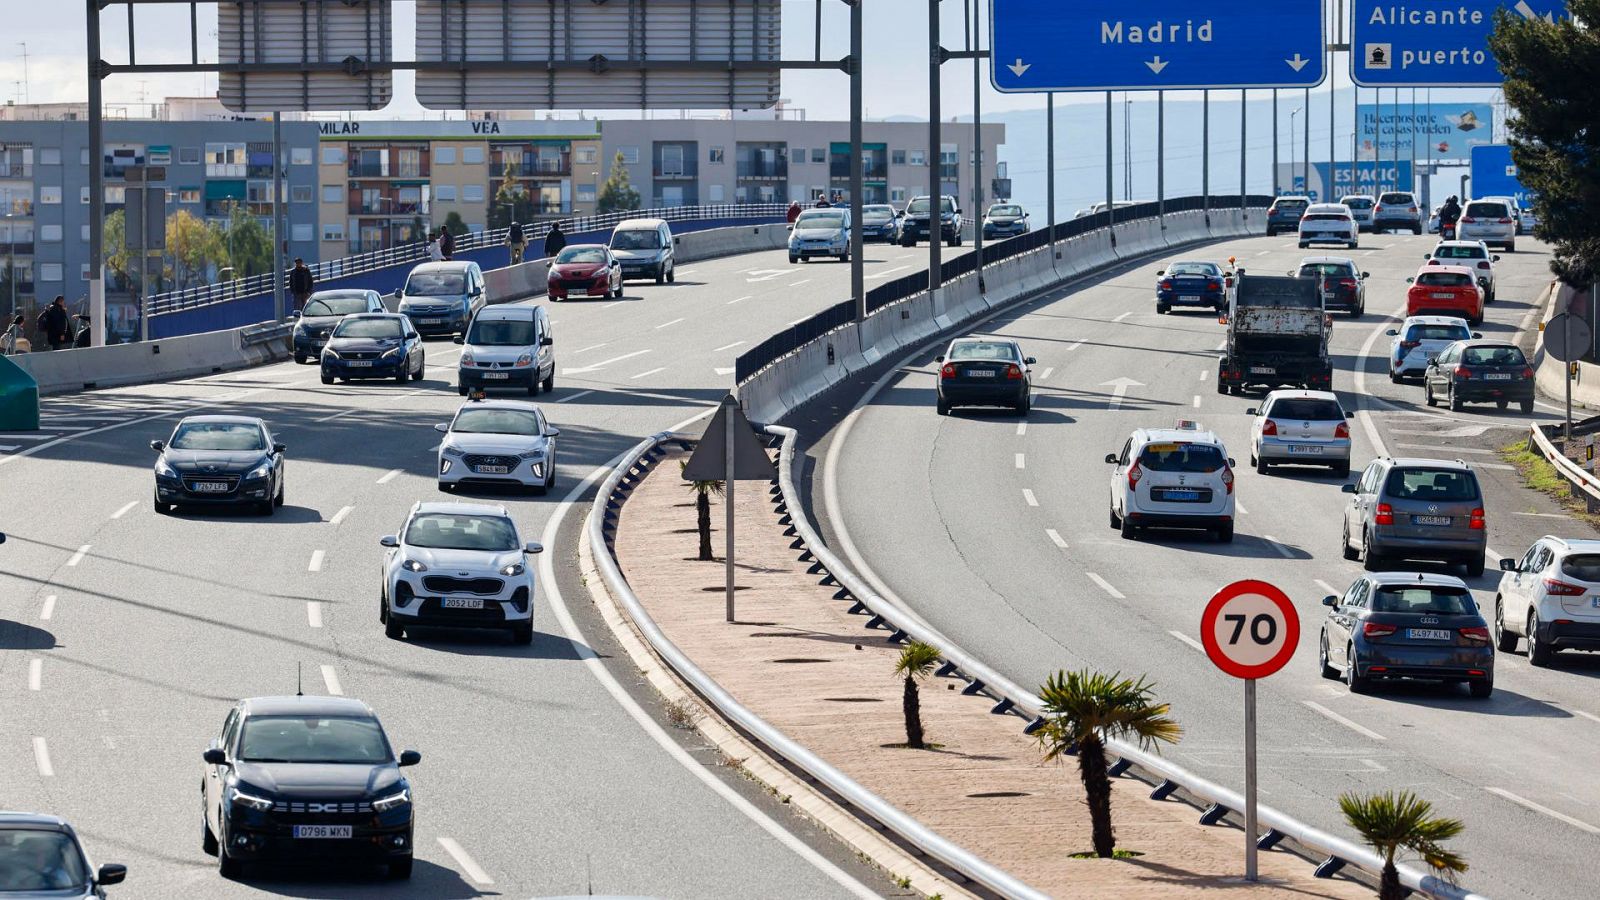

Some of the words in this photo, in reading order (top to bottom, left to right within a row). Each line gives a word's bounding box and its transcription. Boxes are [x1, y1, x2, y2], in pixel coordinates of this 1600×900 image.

[1369, 6, 1483, 25] Alicante
[1101, 19, 1213, 44] Madrid
[1402, 47, 1486, 70] puerto
[319, 122, 360, 134] MILAR
[471, 122, 500, 134] VEA
[1225, 613, 1277, 646] 70
[1411, 629, 1432, 637] 5497
[1433, 630, 1449, 639] KLN
[301, 826, 327, 837] 0796
[330, 826, 350, 837] MKN
